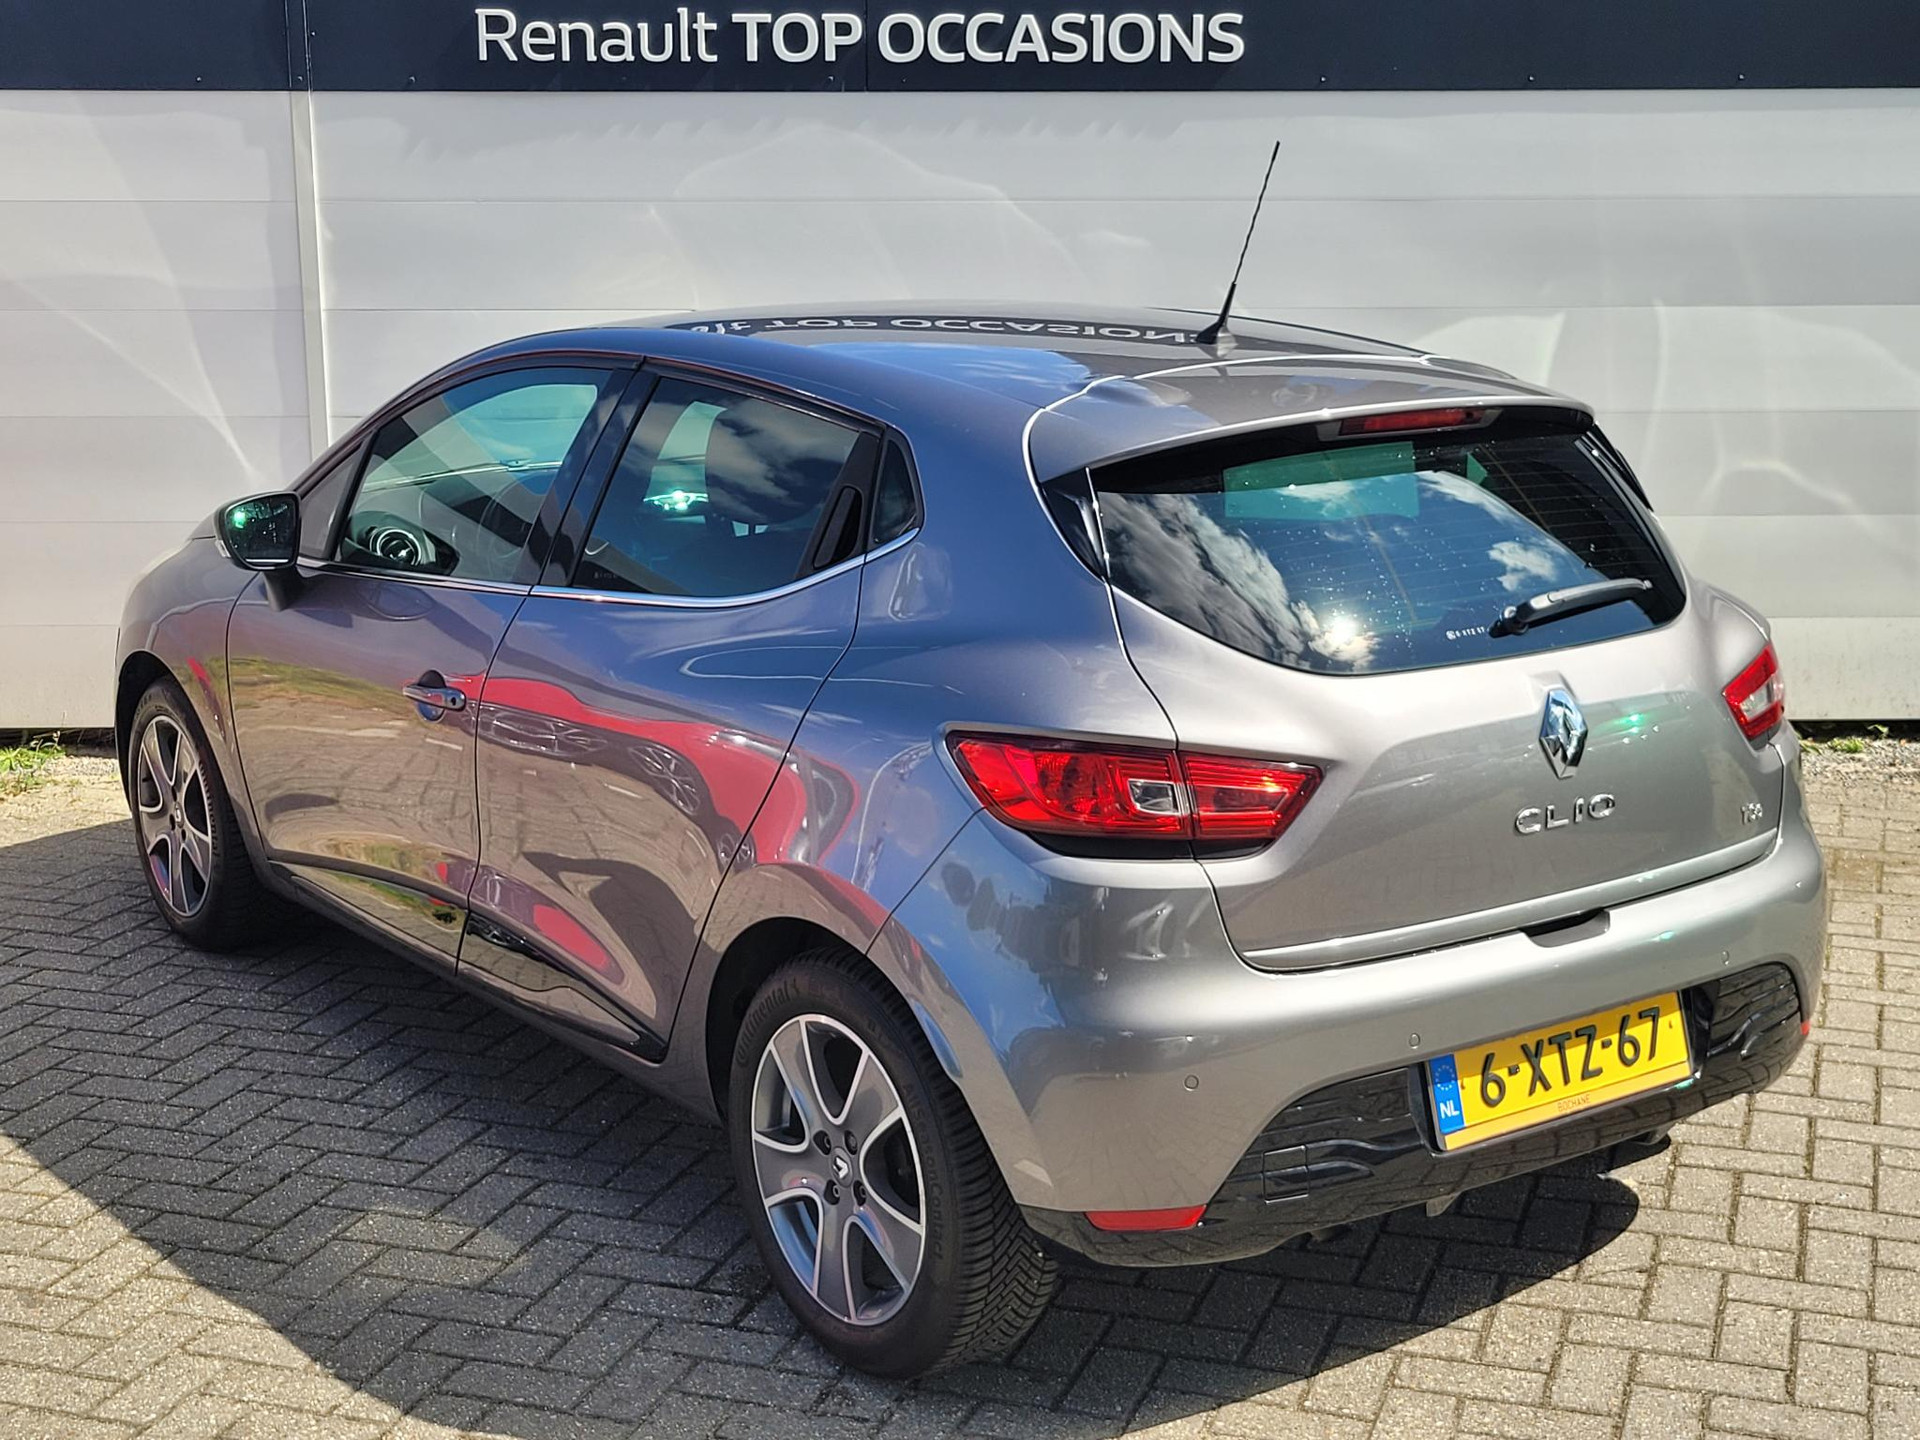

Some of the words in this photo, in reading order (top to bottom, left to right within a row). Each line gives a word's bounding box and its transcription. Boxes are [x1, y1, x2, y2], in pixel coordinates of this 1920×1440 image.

[475, 8, 717, 64] Renault
[732, 13, 862, 64] TOP
[877, 12, 1245, 64] OCCASIONS
[1515, 793, 1615, 834] CLIO
[1480, 1007, 1660, 1108] 6-XTZ-67
[1440, 1100, 1460, 1119] NL
